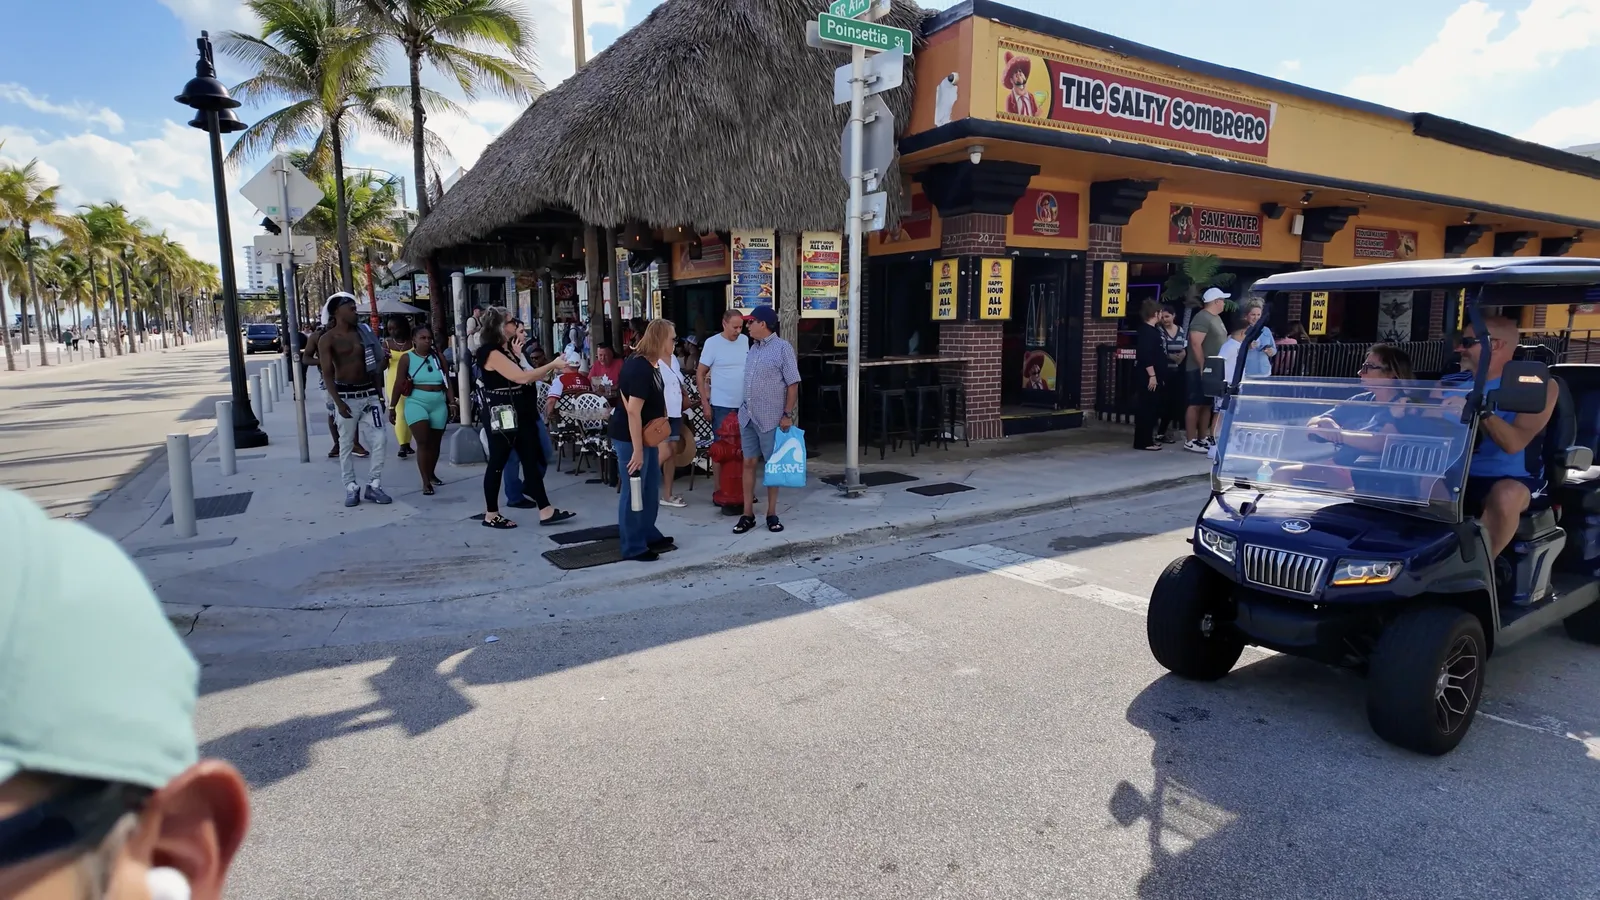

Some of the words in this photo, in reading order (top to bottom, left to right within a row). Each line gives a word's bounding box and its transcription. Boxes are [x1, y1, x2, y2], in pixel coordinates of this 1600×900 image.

[827, 19, 888, 45] Poinsettia
[894, 36, 904, 48] St
[1108, 85, 1169, 123] SALTY
[1201, 210, 1226, 227] SAVE
[1227, 213, 1258, 231] WATER
[978, 234, 995, 244] 201
[1199, 228, 1226, 244] DRINK
[1227, 231, 1261, 247] TEQUILA
[939, 297, 951, 306] ALL
[989, 297, 1002, 305] ALL
[1108, 296, 1119, 305] ALL
[938, 308, 951, 317] DAY
[987, 307, 1002, 316] DAY
[1107, 306, 1120, 314] DAY
[1312, 310, 1323, 319] ALL
[1311, 322, 1323, 331] DAY
